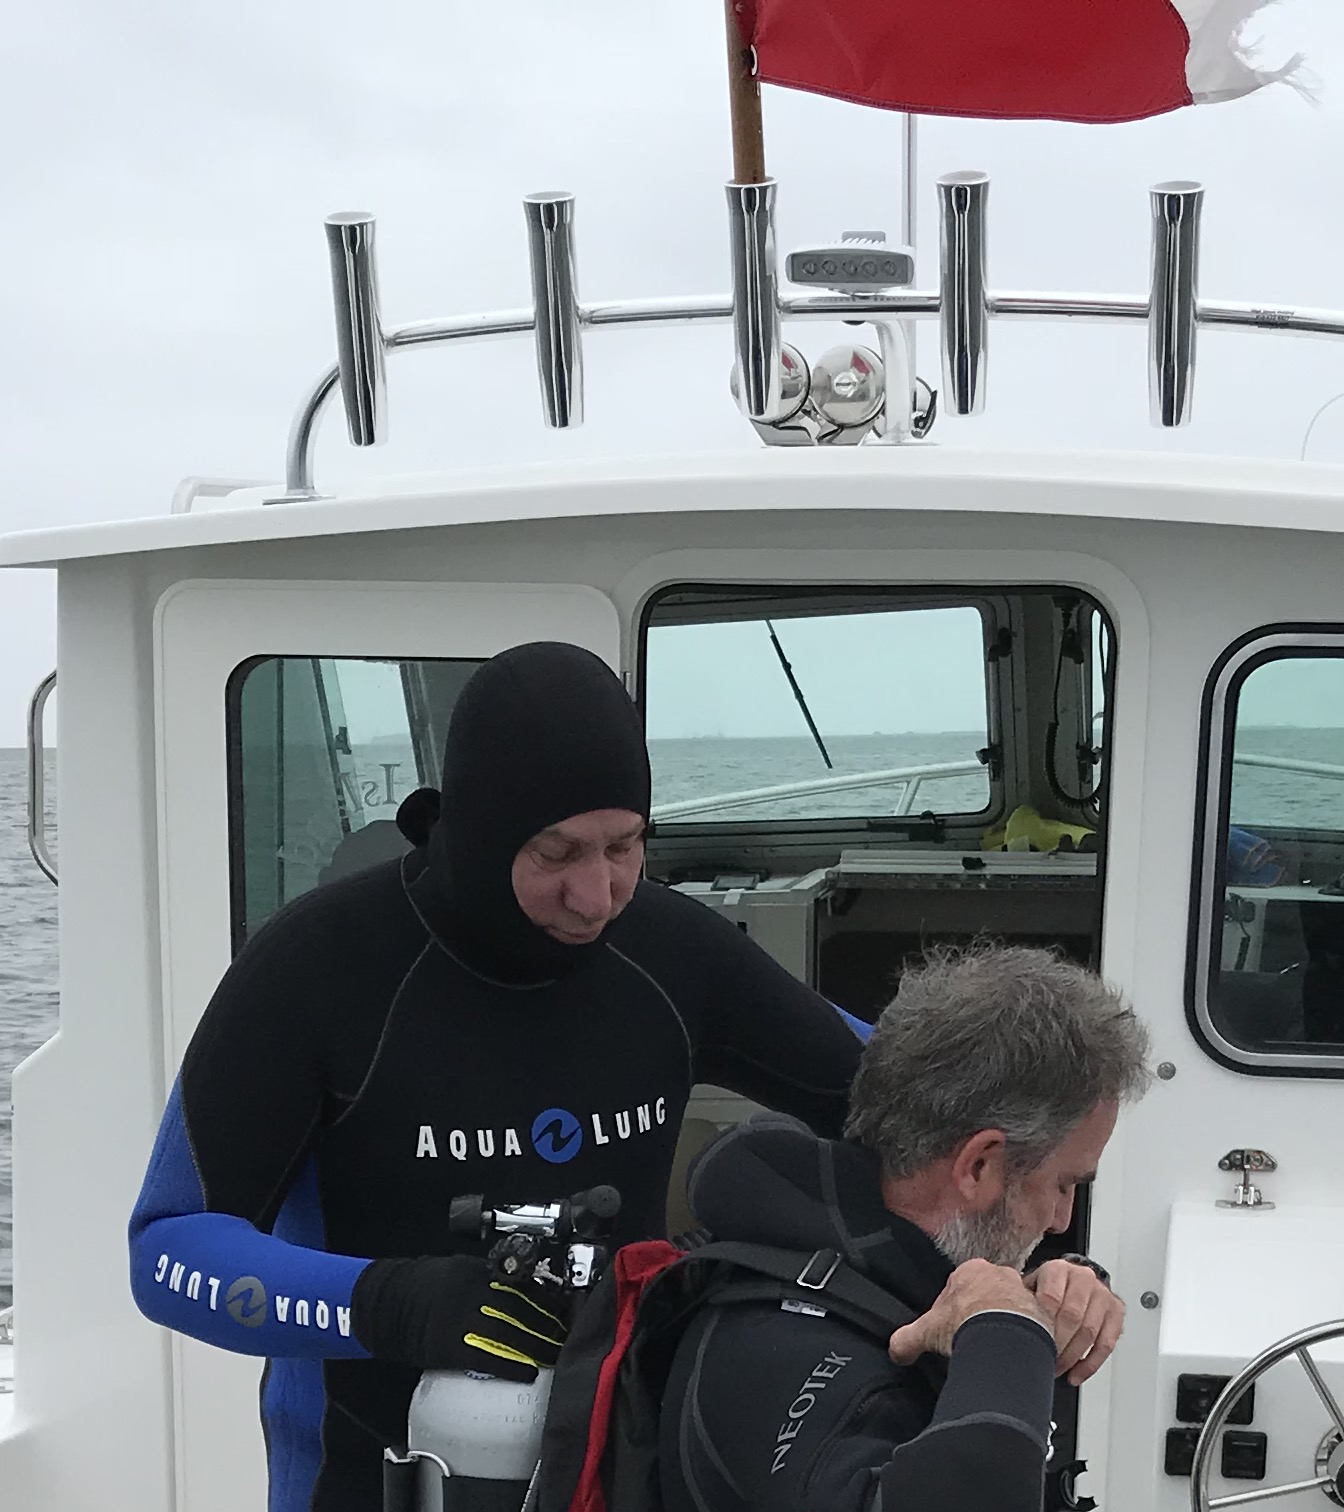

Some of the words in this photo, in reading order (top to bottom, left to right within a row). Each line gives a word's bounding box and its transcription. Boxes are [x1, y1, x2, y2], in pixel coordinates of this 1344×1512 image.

[415, 1125, 523, 1161] AQUA
[591, 1096, 668, 1147] LUNG
[155, 1252, 221, 1312] LUNG
[274, 1295, 353, 1338] AQUA
[770, 1350, 853, 1475] NEOTEK
